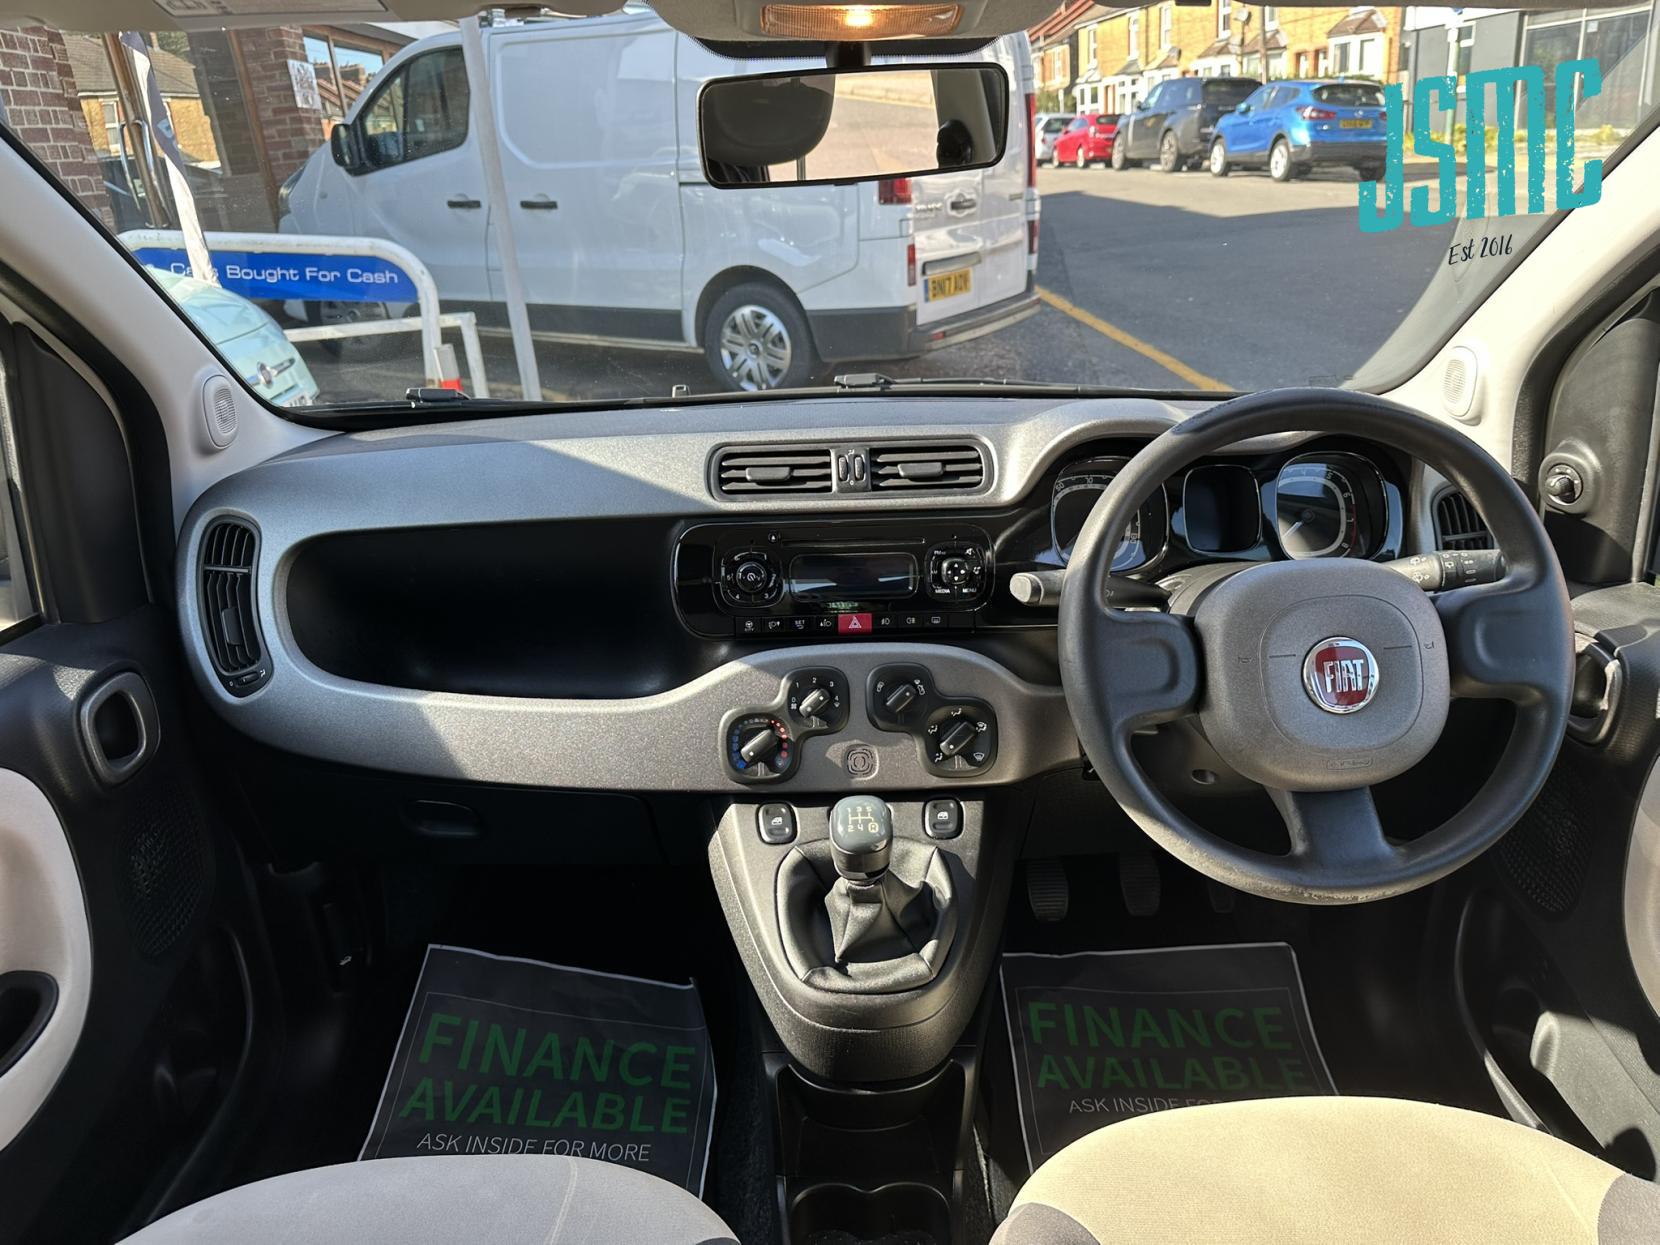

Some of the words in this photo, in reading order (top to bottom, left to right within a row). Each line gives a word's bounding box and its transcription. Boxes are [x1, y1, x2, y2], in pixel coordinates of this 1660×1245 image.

[170, 262, 219, 277] Cas
[226, 265, 300, 284] Bought
[305, 267, 341, 283] For
[346, 268, 399, 284] Cash
[1323, 659, 1364, 693] FIAT
[1028, 1000, 1294, 1050] FINANCE
[418, 1012, 697, 1089] FINANCE
[1037, 1054, 1316, 1094] AVAILABLE
[399, 1076, 693, 1134] AVAILABLE
[1069, 1098, 1110, 1114] ASK
[417, 1133, 461, 1152] ASK
[465, 1135, 538, 1155] INSIDE
[542, 1138, 585, 1157] FOR
[589, 1141, 651, 1162] MORE
